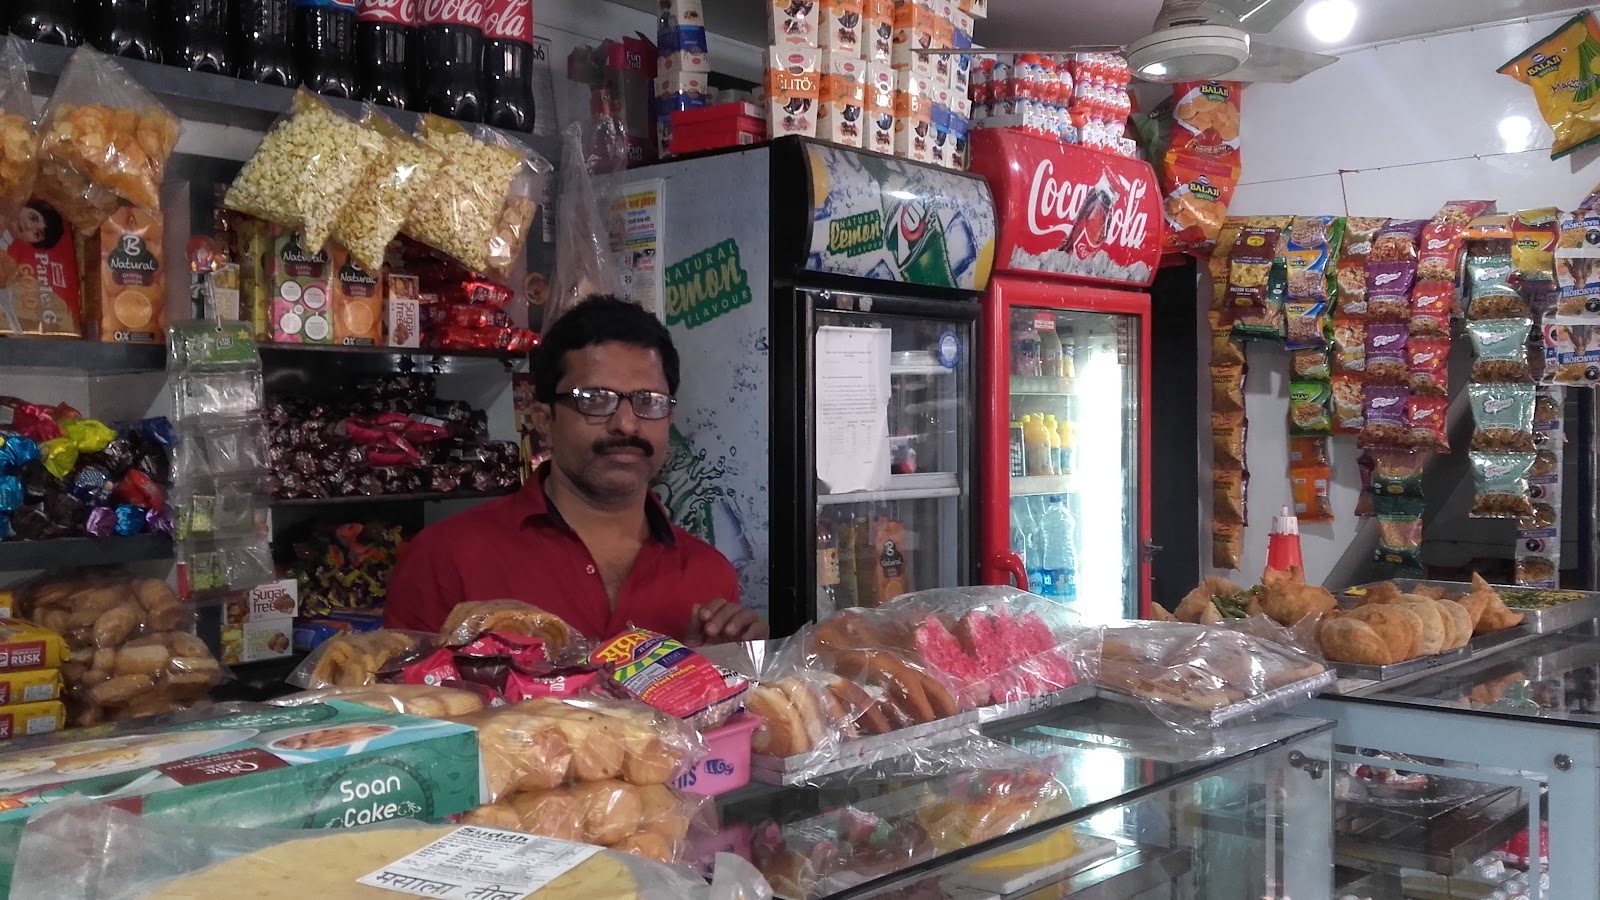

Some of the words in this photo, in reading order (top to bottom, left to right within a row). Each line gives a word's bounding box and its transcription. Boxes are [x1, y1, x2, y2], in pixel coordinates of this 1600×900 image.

[484, 3, 527, 37] ola
[626, 51, 641, 60] Fun
[1527, 56, 1560, 75] BALAJI
[1201, 85, 1229, 97] BALAJI
[1189, 183, 1220, 197] BALAJI
[840, 212, 880, 228] NATURAL
[1563, 219, 1600, 229] MANCHOW
[123, 235, 140, 256] B
[848, 240, 882, 255] FLAVOUR
[110, 257, 155, 271] Natural
[340, 272, 376, 283] Natural
[665, 256, 742, 317] emon
[1562, 286, 1600, 297] MANCHOW
[396, 302, 405, 325] free
[687, 289, 748, 324] FLAVOUR
[404, 302, 415, 336] Sugar
[1562, 353, 1600, 363] MANCHOW
[253, 588, 286, 602] Sugar
[253, 599, 277, 613] free
[11, 653, 41, 666] RUSK
[340, 775, 400, 803] Soan
[344, 802, 398, 828] Cake
[463, 827, 529, 842] Suddh
[376, 871, 462, 895] मसाला
